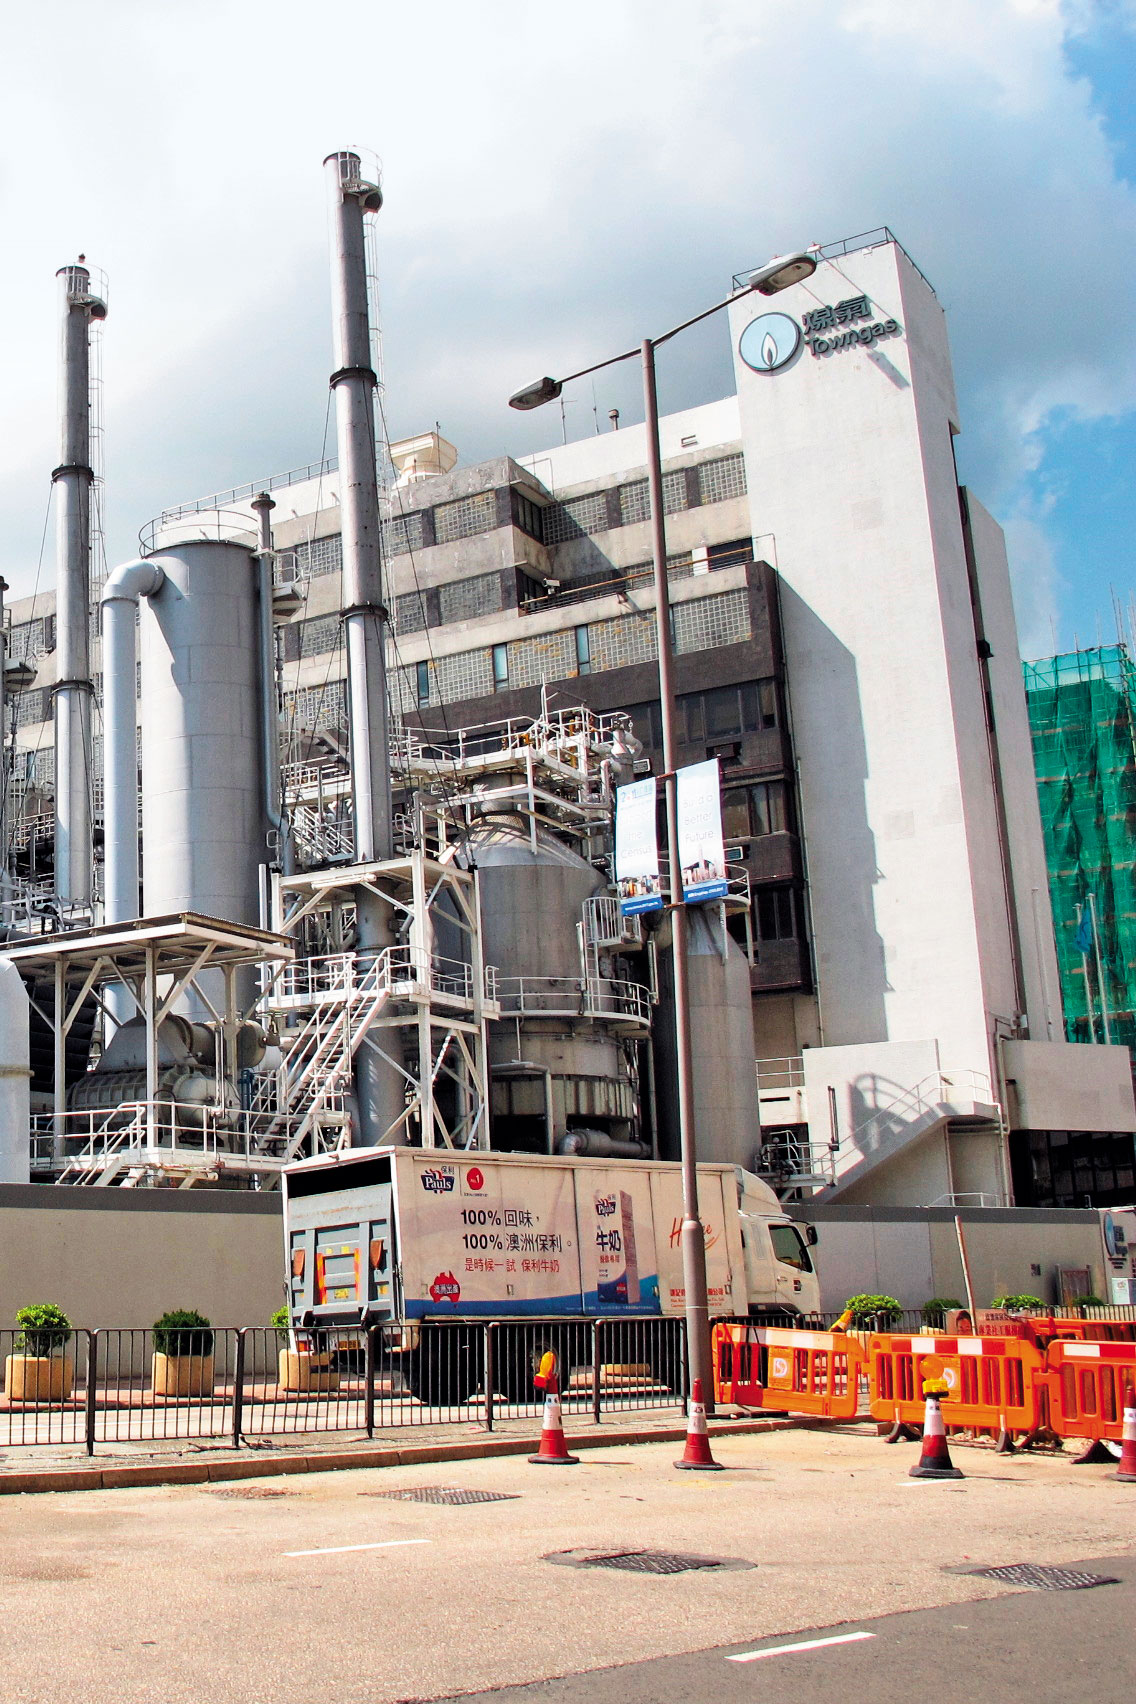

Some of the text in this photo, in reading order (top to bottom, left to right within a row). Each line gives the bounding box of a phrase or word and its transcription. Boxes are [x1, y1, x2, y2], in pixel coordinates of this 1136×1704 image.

[804, 318, 898, 356] Towngas
[683, 811, 713, 826] Better
[685, 830, 714, 843] Future
[620, 845, 653, 859] Census
[424, 1176, 452, 1189] Pauls
[461, 1209, 502, 1226] 100%
[462, 1233, 503, 1250] 100%
[595, 1229, 622, 1252] 牛奶
